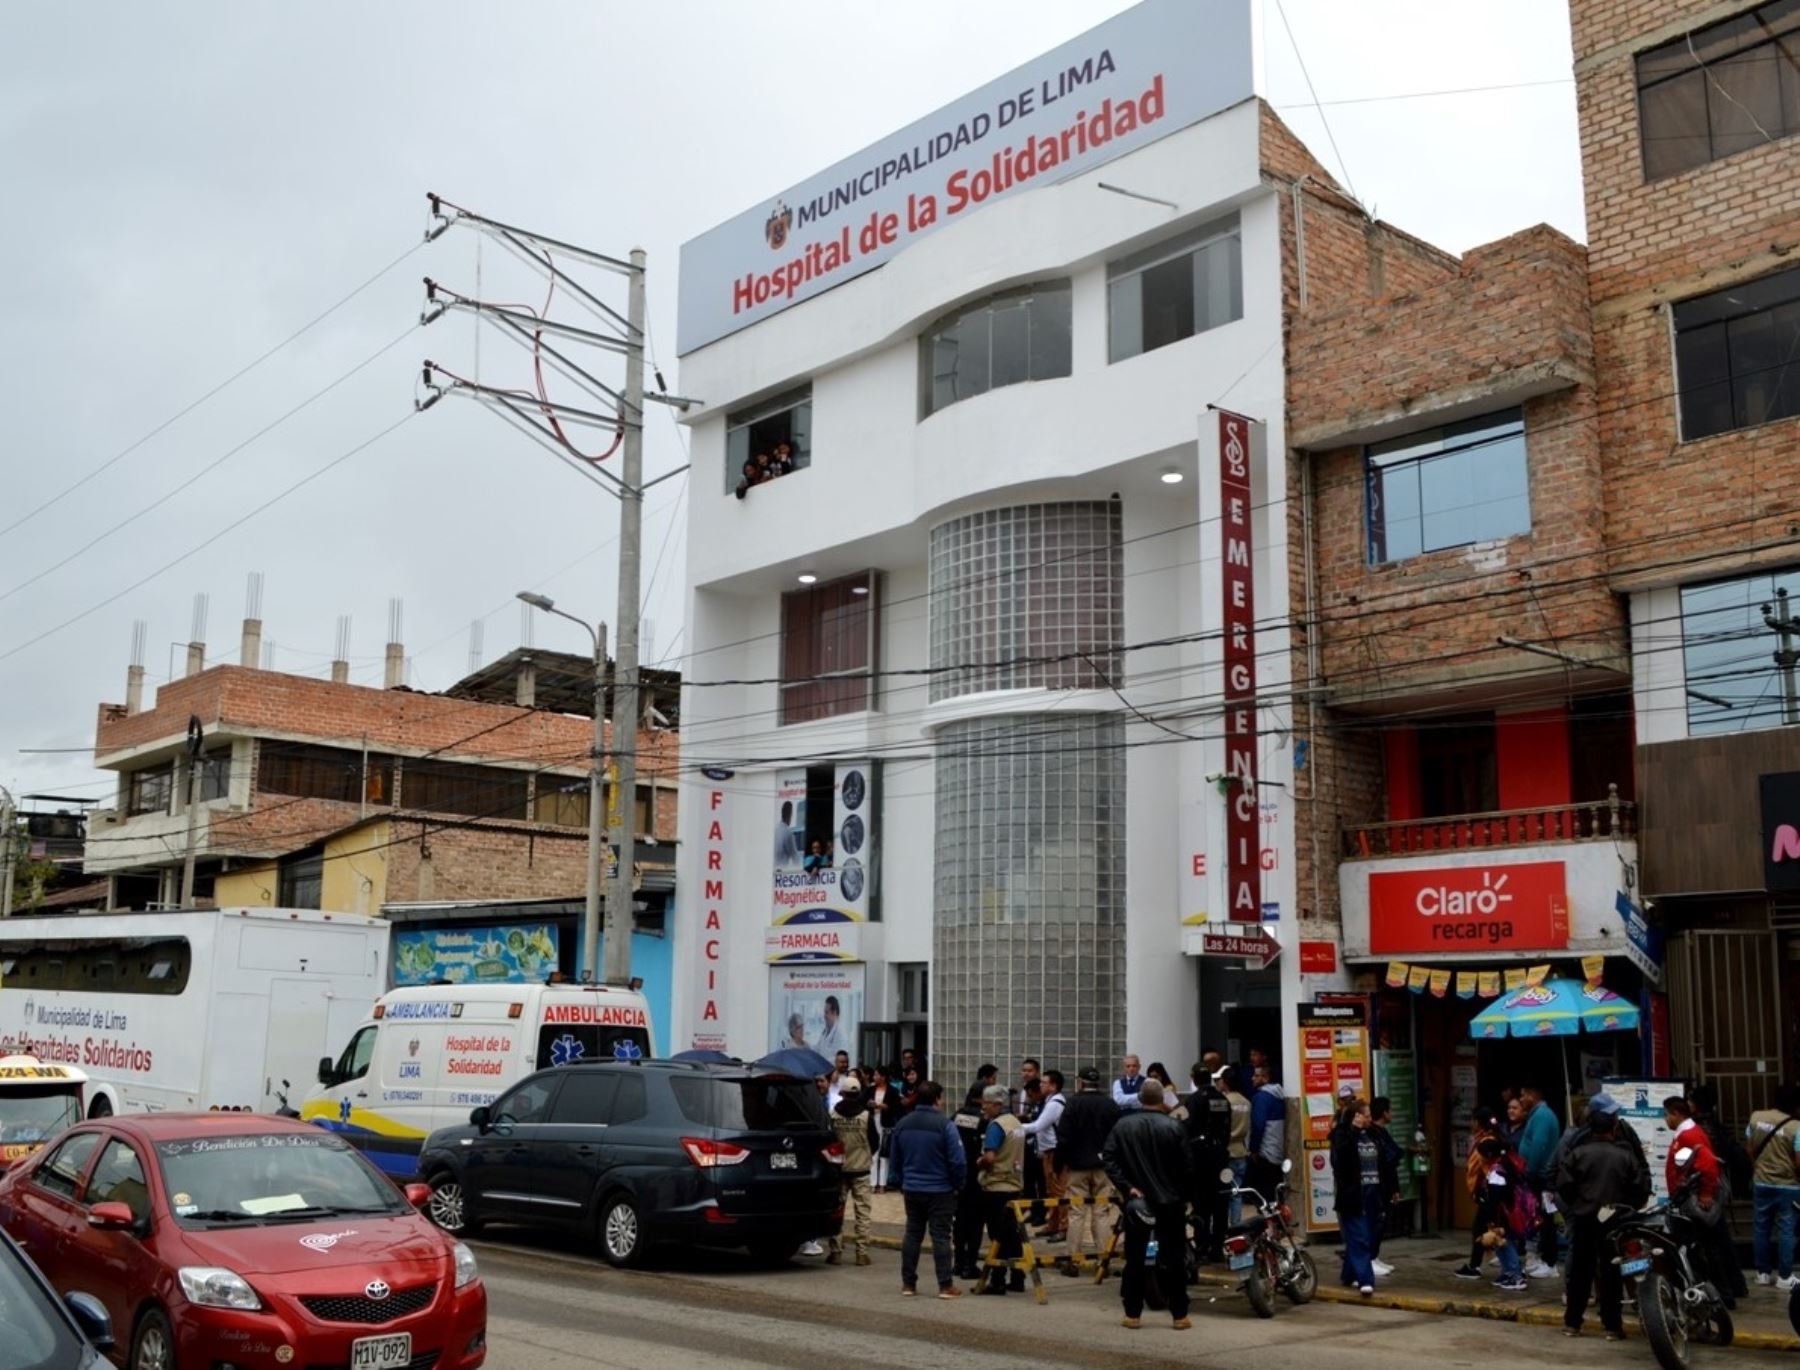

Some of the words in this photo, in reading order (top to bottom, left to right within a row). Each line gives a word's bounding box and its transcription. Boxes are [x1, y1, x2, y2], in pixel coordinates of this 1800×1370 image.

[797, 111, 992, 230] MUNICIPALIDAD
[998, 87, 1035, 129] DE
[1042, 48, 1117, 108] LIMA
[733, 226, 852, 315] Hospital
[859, 210, 898, 254] de
[907, 192, 937, 235] la
[946, 74, 1165, 216] Solidaridad
[1228, 496, 1254, 910] EMERGENCIA
[774, 871, 836, 888] Resonancia
[703, 791, 723, 1021] FARMACIA
[774, 888, 827, 908] Magnética
[1416, 882, 1499, 916] Claro
[781, 932, 840, 949] FARMACIA
[1432, 920, 1513, 944] recarga
[1204, 937, 1223, 951] Las
[1225, 938, 1238, 951] 24
[1240, 939, 1270, 954] horas
[37, 1005, 91, 1029] Municipalidad
[93, 1010, 103, 1029] de
[105, 1010, 127, 1031] Lima
[389, 1003, 448, 1019] AMBULANCIA
[544, 1006, 647, 1026] AMBULANCIA
[84, 1036, 152, 1072] Solidarios
[446, 1036, 485, 1054] Hospital
[486, 1036, 499, 1051] de
[501, 1036, 511, 1051] la
[399, 1065, 420, 1078] LIMA
[448, 1058, 502, 1075] Solidaridad
[261, 1135, 285, 1147] De
[287, 1135, 320, 1147] Dios
[354, 1341, 406, 1365] M1V-092
